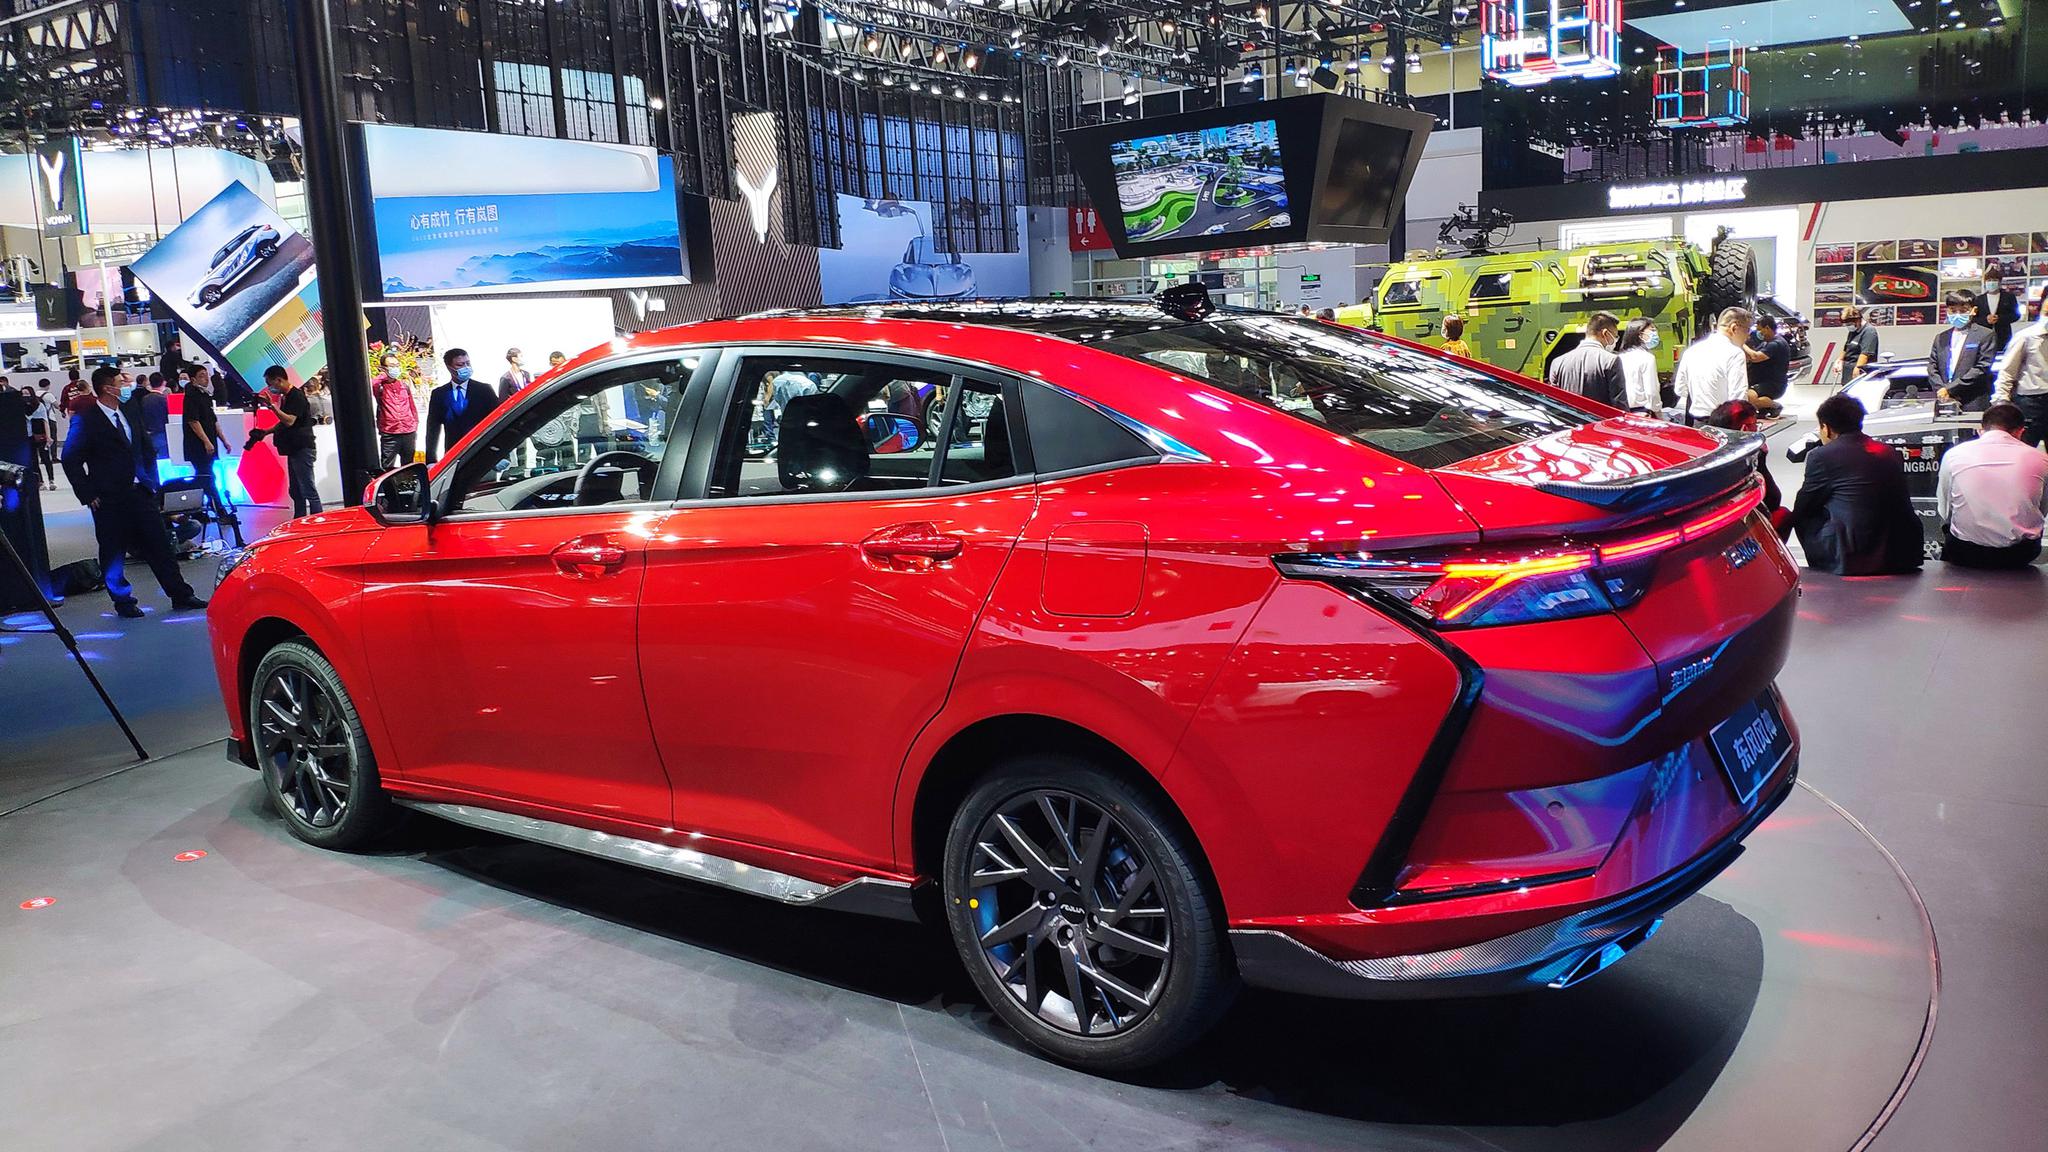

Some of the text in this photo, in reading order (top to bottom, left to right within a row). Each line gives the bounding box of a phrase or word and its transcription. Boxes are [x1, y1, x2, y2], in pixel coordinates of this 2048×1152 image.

[410, 204, 499, 230] 心有成竹 行有岚图
